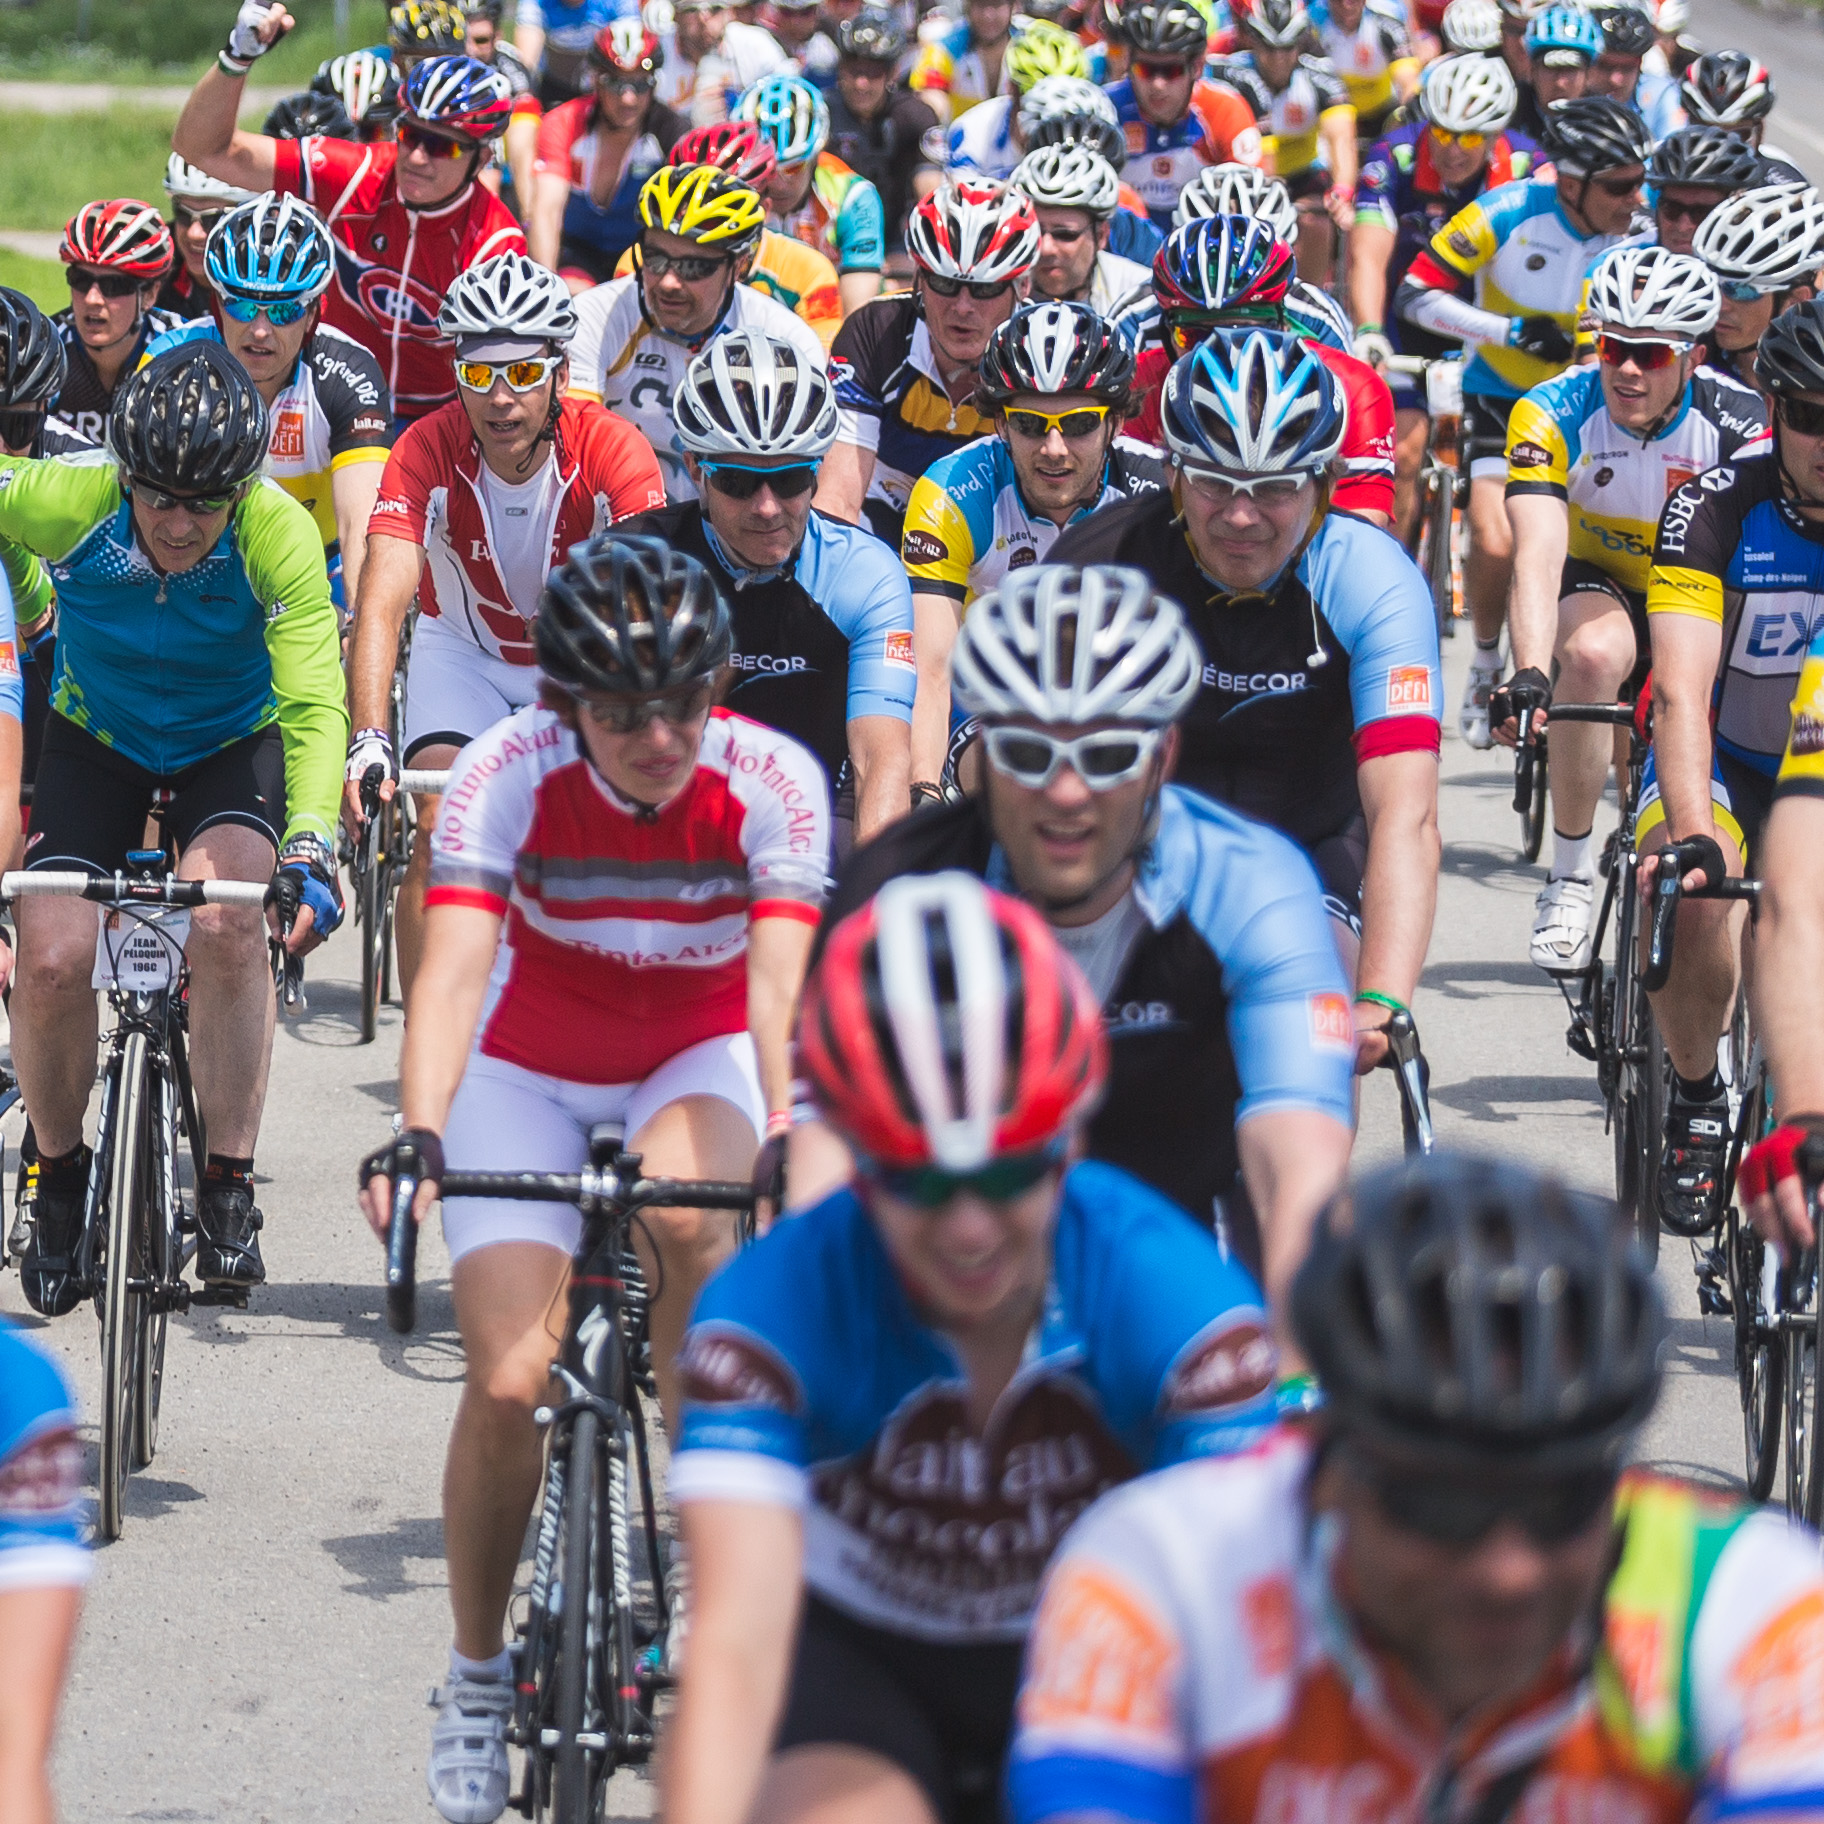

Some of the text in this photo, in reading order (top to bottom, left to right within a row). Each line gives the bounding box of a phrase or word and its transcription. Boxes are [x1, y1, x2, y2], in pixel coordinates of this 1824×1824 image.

[1661, 482, 1705, 555] HSBC
[728, 653, 807, 674] BECOR
[1390, 678, 1430, 703] DÉFI
[133, 937, 157, 949] JEAN
[123, 948, 166, 960] PÉLOQUIN
[132, 962, 158, 973] 196C
[1689, 1118, 1722, 1137] SIDI
